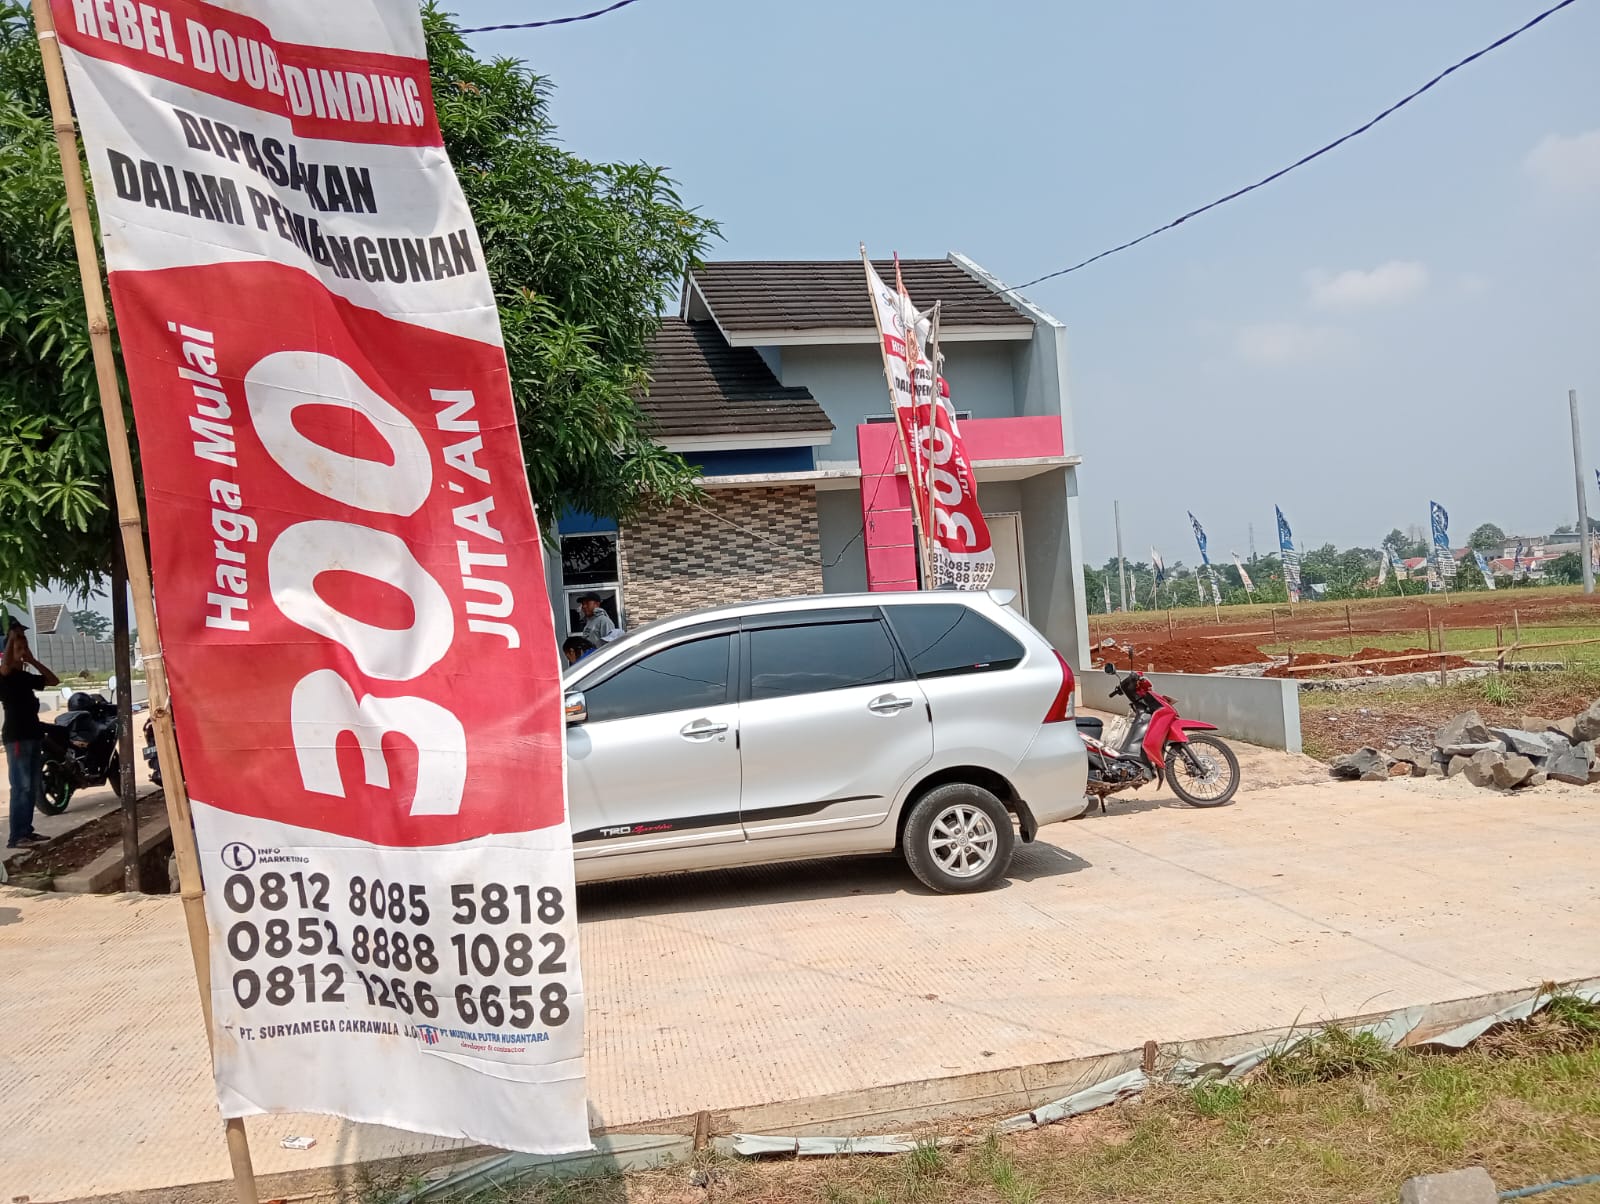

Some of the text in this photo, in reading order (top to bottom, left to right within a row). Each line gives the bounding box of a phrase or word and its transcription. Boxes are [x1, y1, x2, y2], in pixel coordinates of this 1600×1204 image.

[282, 64, 424, 127] DINDING
[107, 147, 245, 225] DALAM
[167, 321, 258, 632] Harga Mulai
[919, 426, 977, 547] 300
[243, 350, 468, 817] 300
[258, 847, 310, 864] INFO MARKETING
[600, 826, 631, 836] TRD
[224, 872, 565, 926] 0812 8085 5818
[227, 918, 567, 977] 0852 8888 1082
[232, 963, 570, 1029] 0812 1266 6658
[240, 1027, 255, 1040] PT.
[259, 1020, 336, 1039] SURYAMEGA
[339, 1019, 399, 1035] CAKRAWALA
[479, 1033, 500, 1041] PUTRA
[501, 1032, 549, 1043] NUSANTARA
